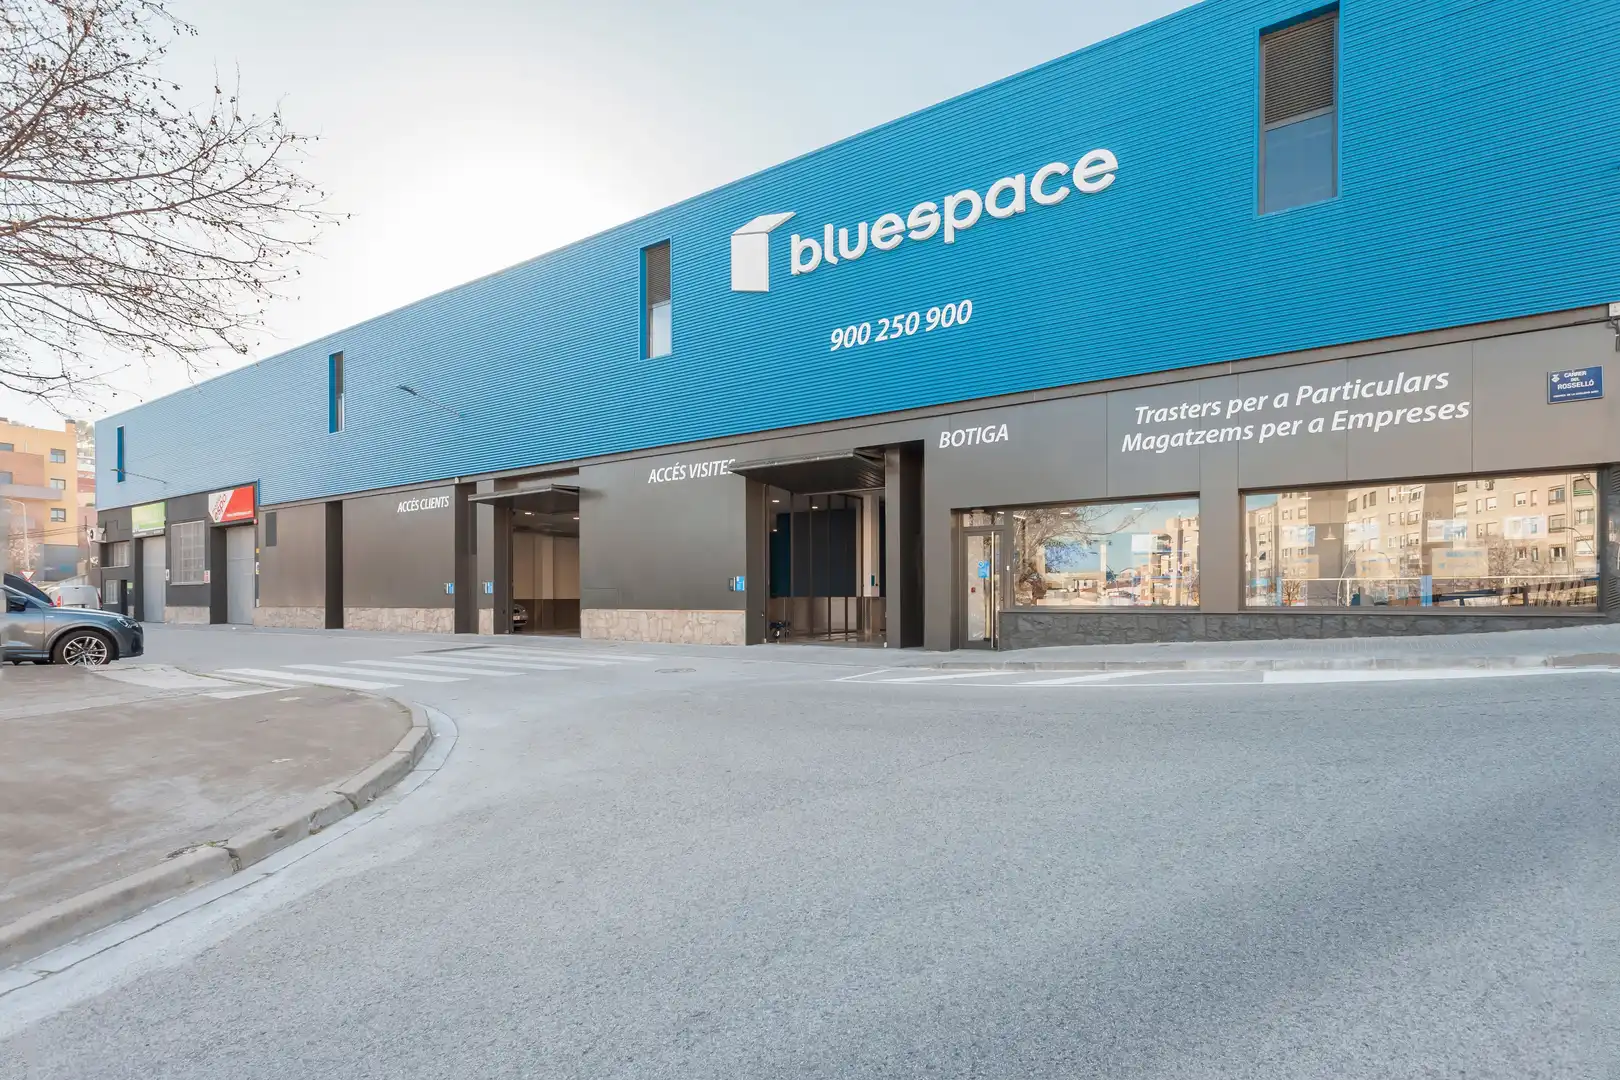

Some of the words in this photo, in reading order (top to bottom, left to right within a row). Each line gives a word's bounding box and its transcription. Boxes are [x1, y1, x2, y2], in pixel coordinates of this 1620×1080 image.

[790, 148, 1119, 275] bluespace
[830, 323, 871, 352] 900
[874, 312, 920, 343] 250
[925, 299, 973, 332] 900
[1135, 400, 1222, 425] Trasters
[1226, 394, 1269, 420] per
[1273, 392, 1290, 409] a
[1296, 371, 1450, 406] Particulars
[1557, 379, 1594, 390] ROSSELLÓ
[938, 423, 1009, 449] BOTIGA
[1121, 424, 1255, 454] Magatzems
[1259, 419, 1304, 444] per
[1307, 417, 1325, 434] a
[1330, 401, 1470, 433] Empreses
[648, 462, 687, 484] ACCÉS
[397, 497, 420, 513] ACCÉS
[420, 495, 450, 510] CLIENTS
